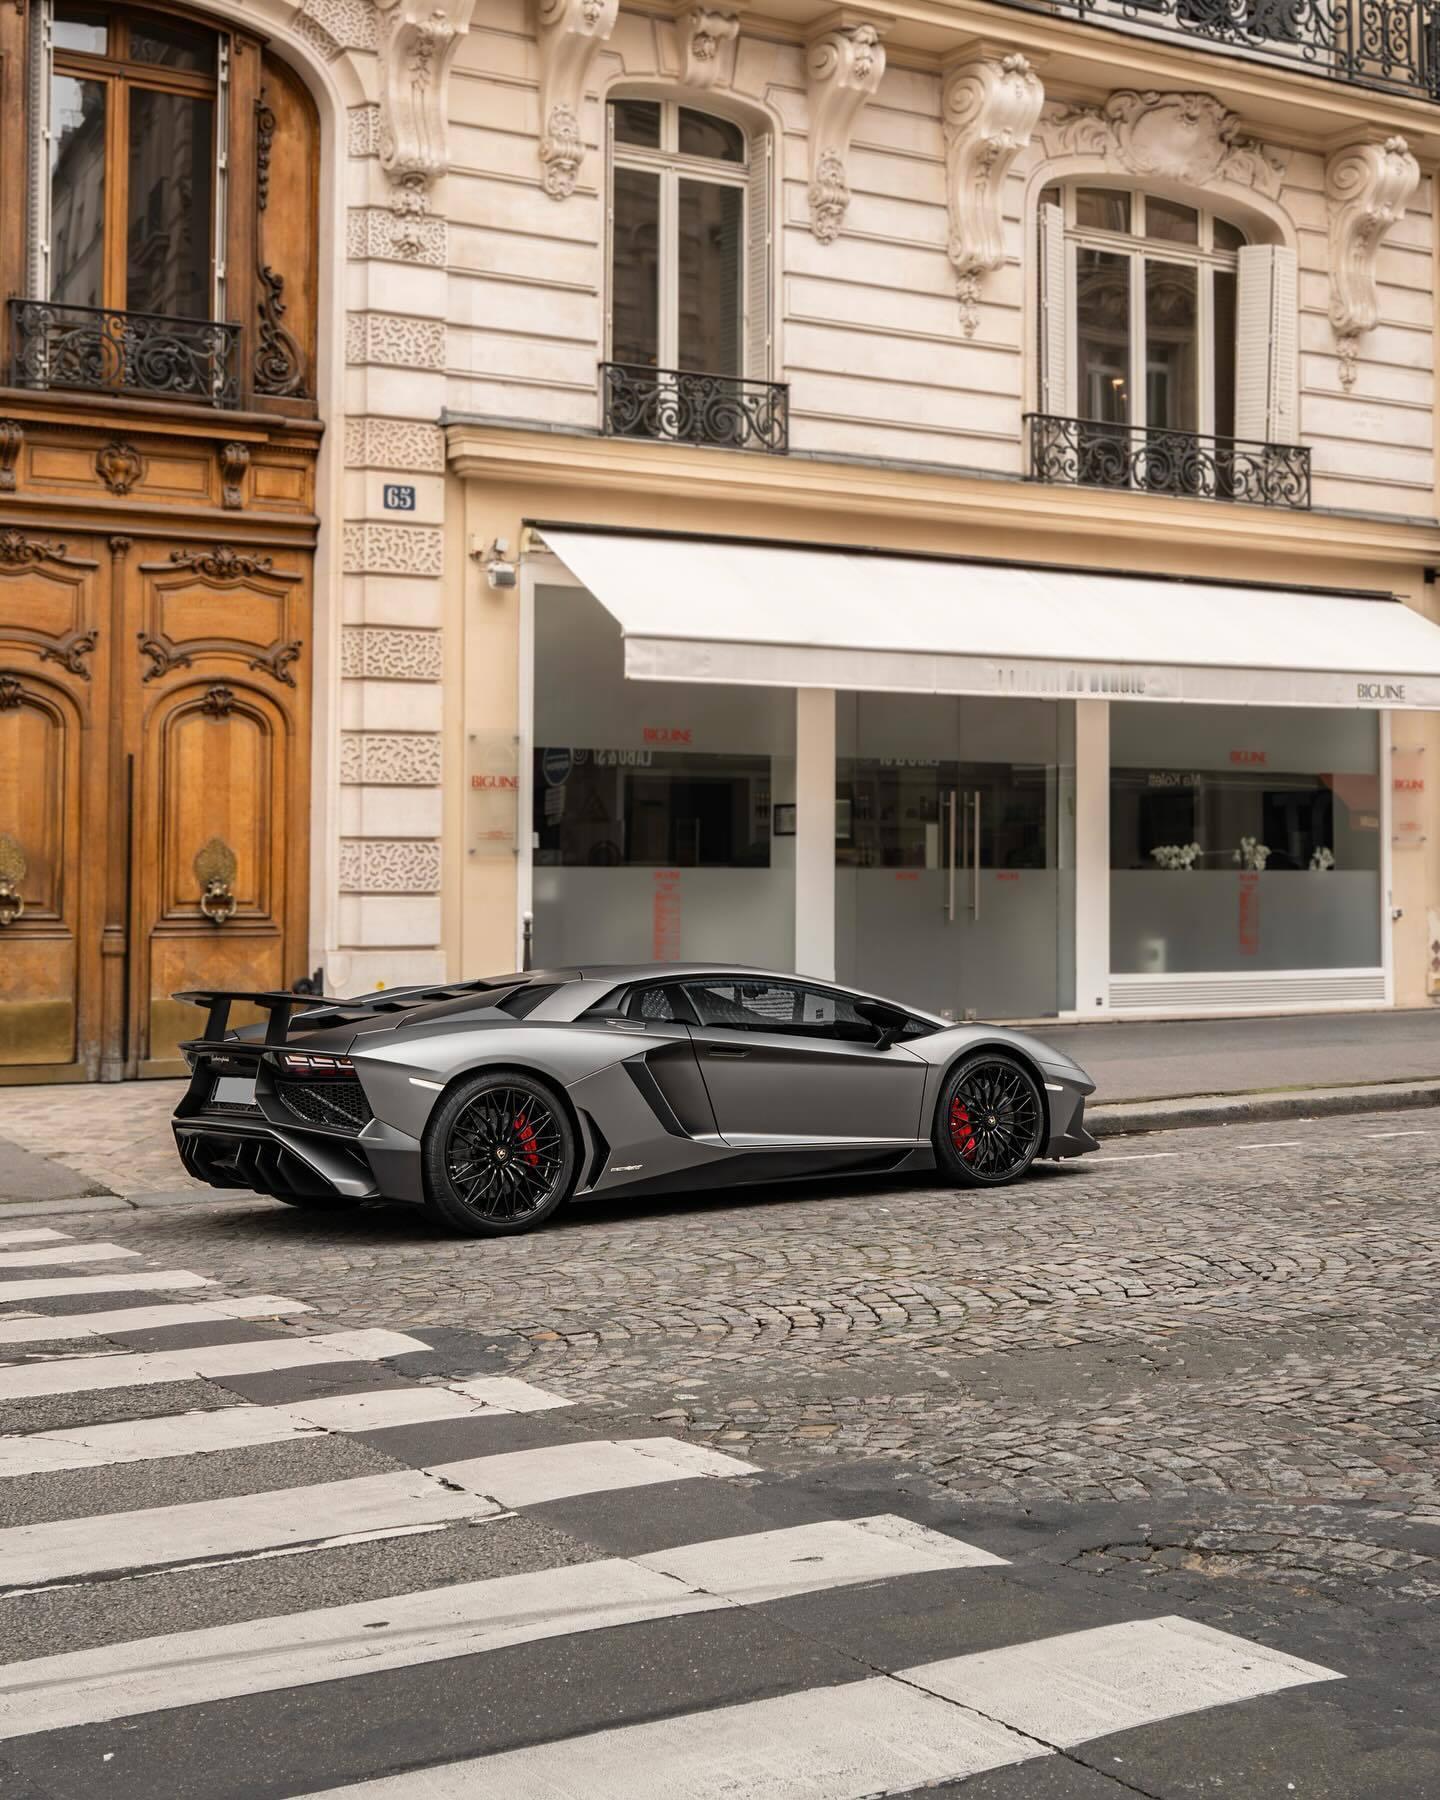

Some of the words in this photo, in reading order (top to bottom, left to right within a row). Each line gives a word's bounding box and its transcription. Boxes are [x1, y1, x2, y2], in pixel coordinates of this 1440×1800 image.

[387, 487, 412, 509] 65
[1357, 683, 1406, 698] BIGUINE
[471, 775, 521, 788] BIGUINE
